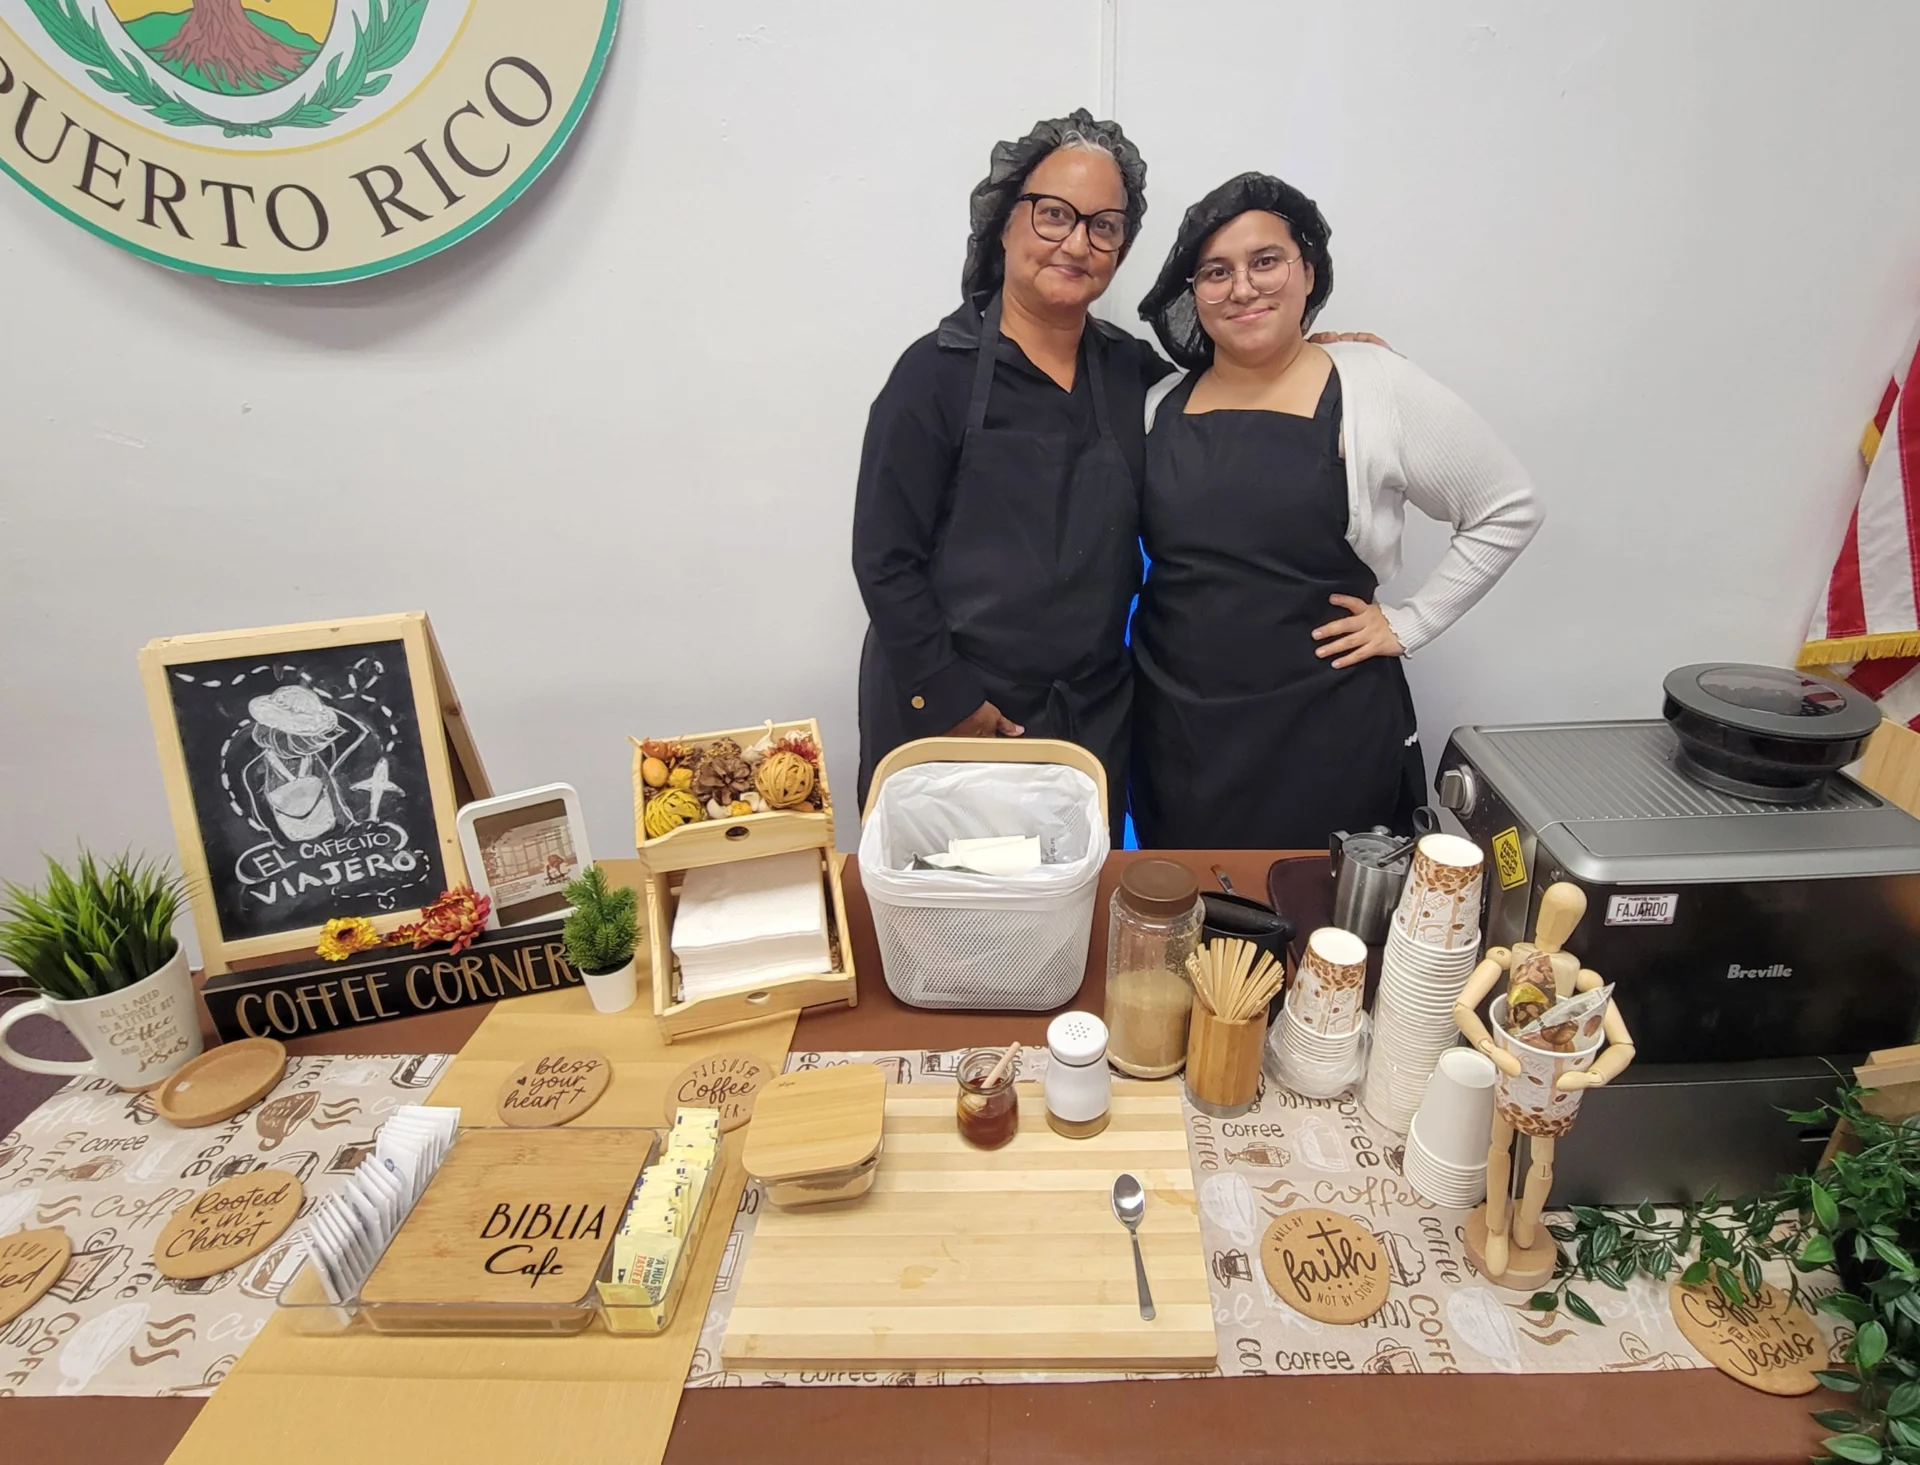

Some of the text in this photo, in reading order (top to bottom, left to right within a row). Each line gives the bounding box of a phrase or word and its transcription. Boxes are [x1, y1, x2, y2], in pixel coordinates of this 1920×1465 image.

[349, 56, 552, 238] RICO
[252, 850, 297, 877] EL
[1616, 902, 1668, 918] FAJARDO
[1727, 964, 1792, 978] Breville
[100, 1008, 118, 1018] ALL
[132, 989, 160, 1008] NEED
[235, 943, 579, 1038] COFFEE CORNER
[536, 1056, 602, 1074] bless
[701, 1059, 748, 1077] JESUS
[504, 1089, 570, 1110] heart
[528, 1076, 586, 1096] your
[678, 1076, 756, 1104] Coffee
[190, 1182, 290, 1218] Rooted
[217, 1210, 248, 1228] in
[479, 1203, 606, 1240] BIBLIA
[1272, 1216, 1304, 1242] WALK BY
[2, 1242, 48, 1260] ESUS
[165, 1219, 272, 1258] Christ
[484, 1244, 564, 1288] Cafe
[632, 1255, 646, 1278] TASTE
[1283, 1220, 1376, 1302] faith
[650, 1268, 664, 1284] HUG
[1317, 1274, 1377, 1306] NOT BY SIGHT
[1681, 1286, 1772, 1328] Coffee
[1748, 1326, 1772, 1344] AND
[1720, 1332, 1814, 1376] Jesus
